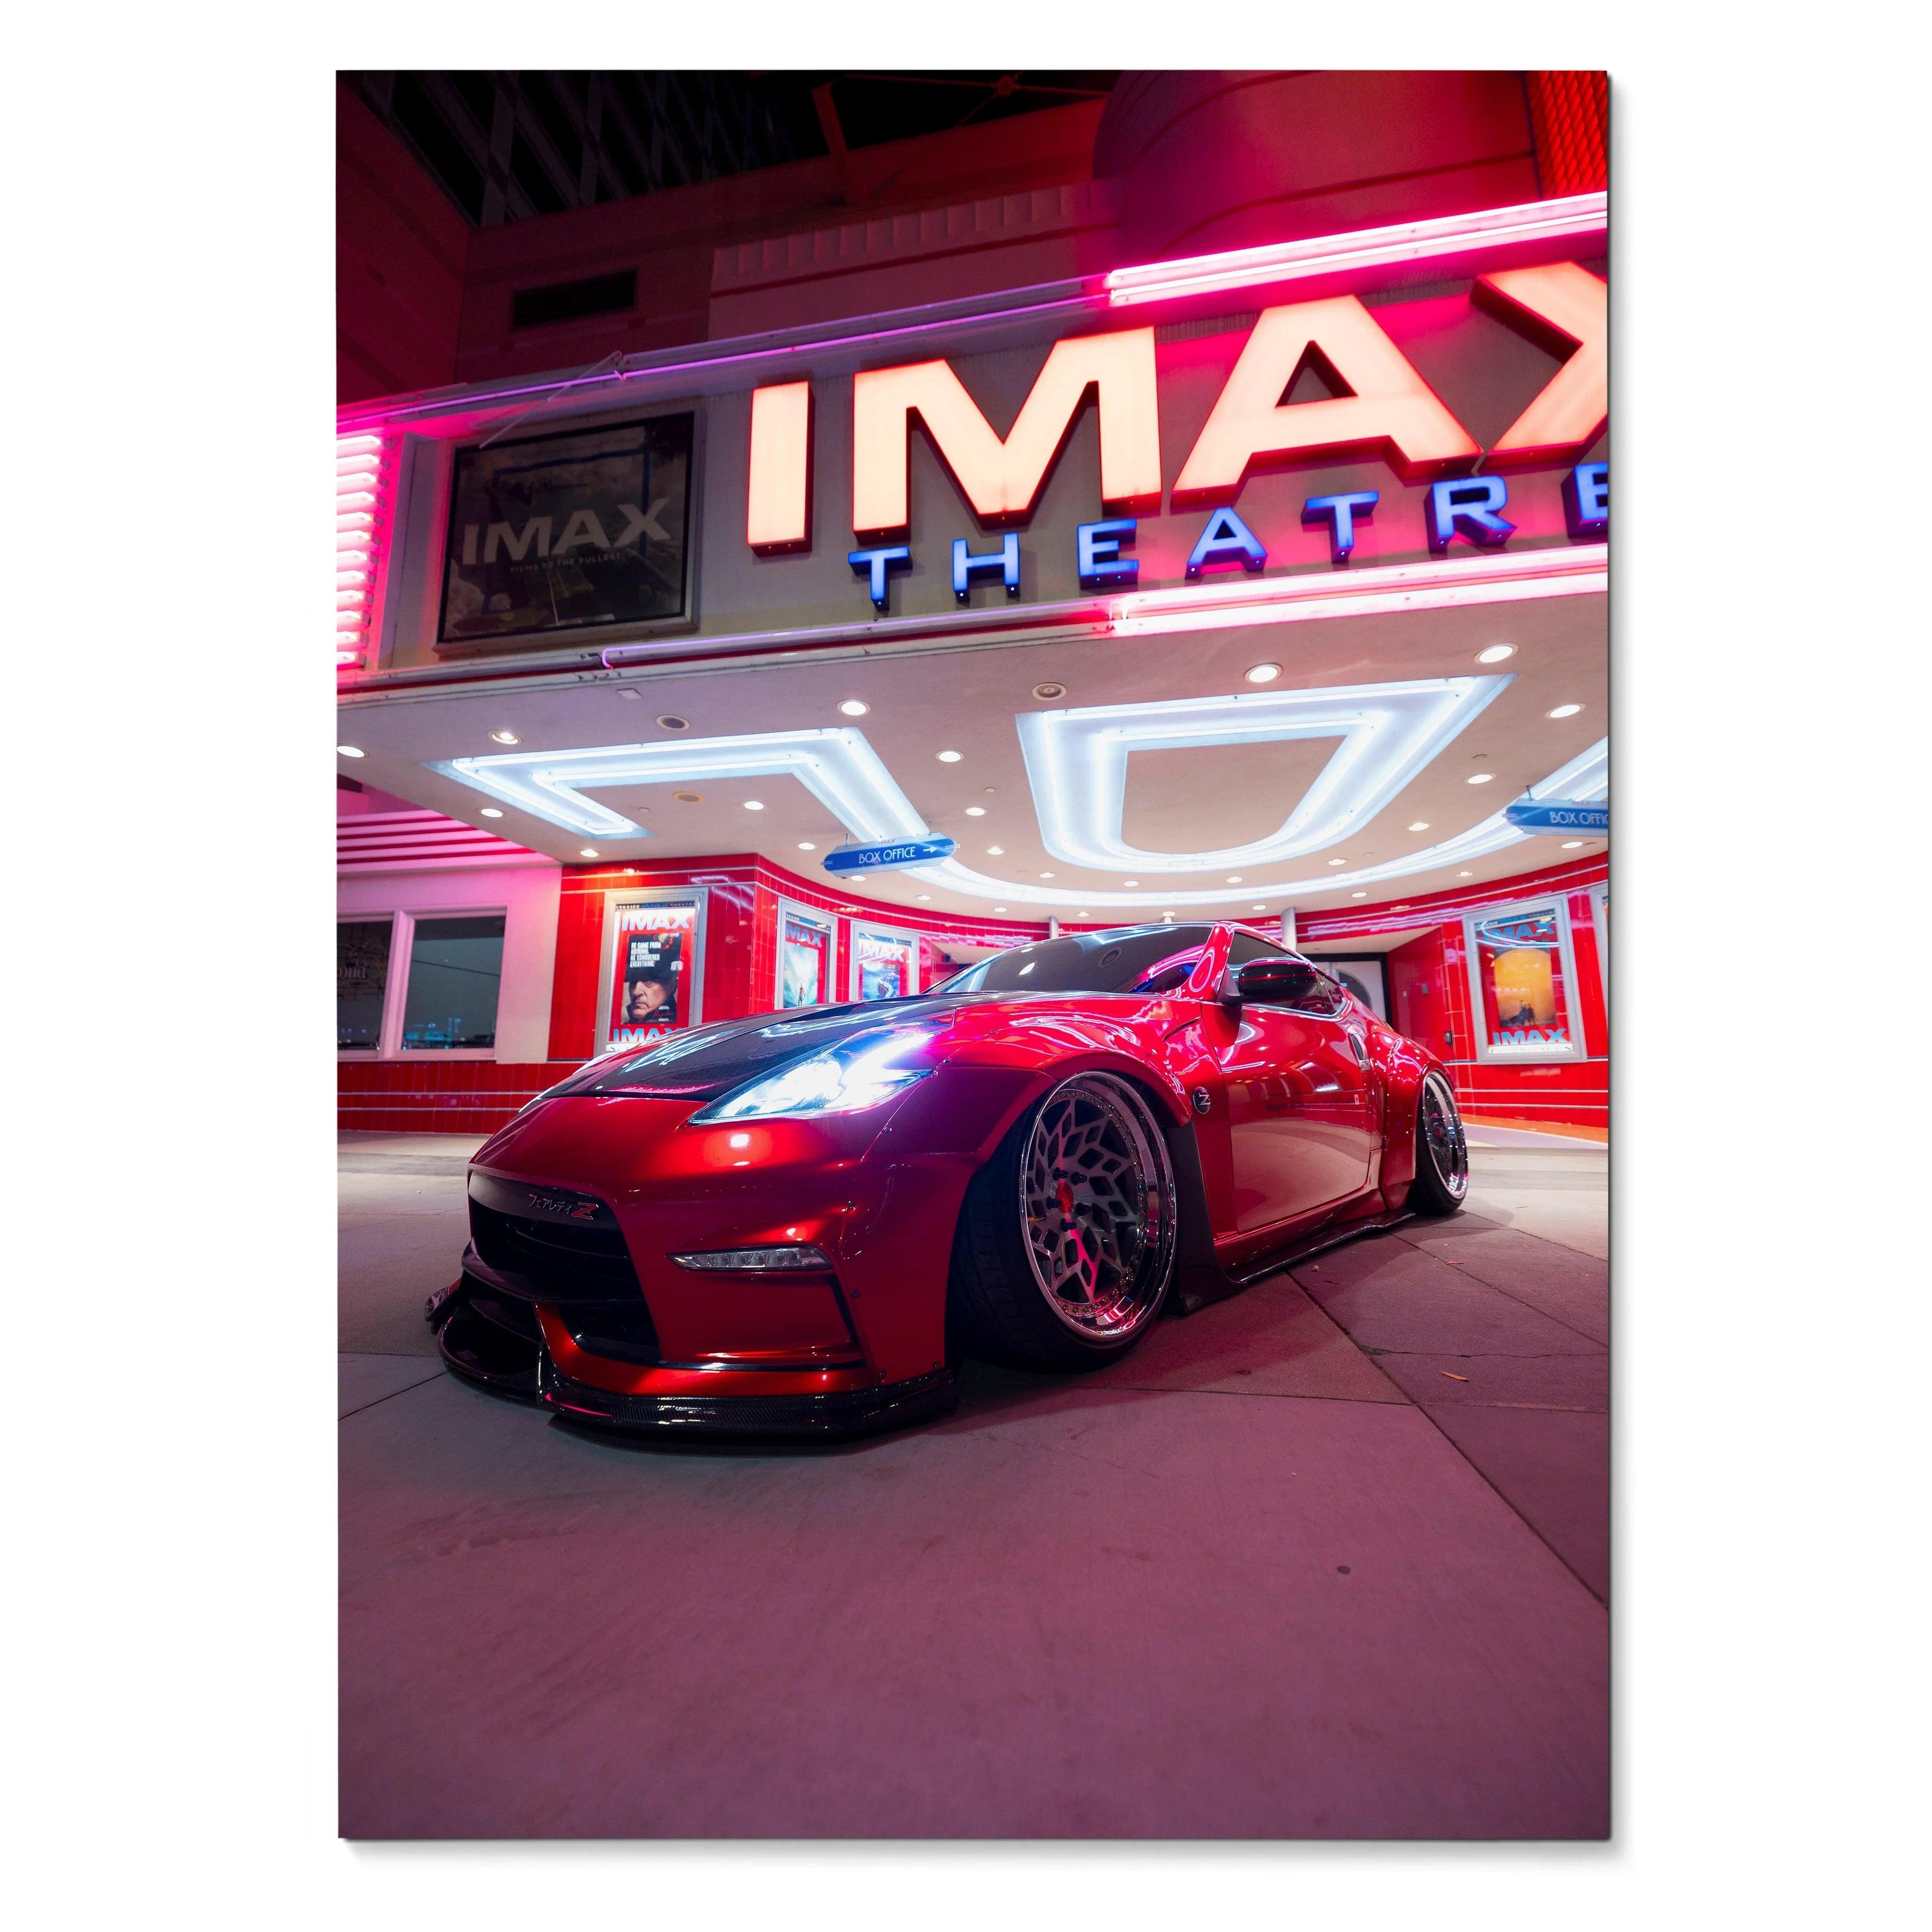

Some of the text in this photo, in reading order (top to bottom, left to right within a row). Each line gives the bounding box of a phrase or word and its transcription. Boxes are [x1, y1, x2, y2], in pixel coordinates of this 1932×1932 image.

[462, 498, 672, 565] IMAX
[557, 557, 575, 567] THE
[1549, 811, 1578, 824] BOX
[858, 846, 916, 864] BOX OFFICE
[621, 913, 690, 931] IMAX
[613, 1027, 687, 1043] IMA
[1492, 1028, 1567, 1046] IMAX
